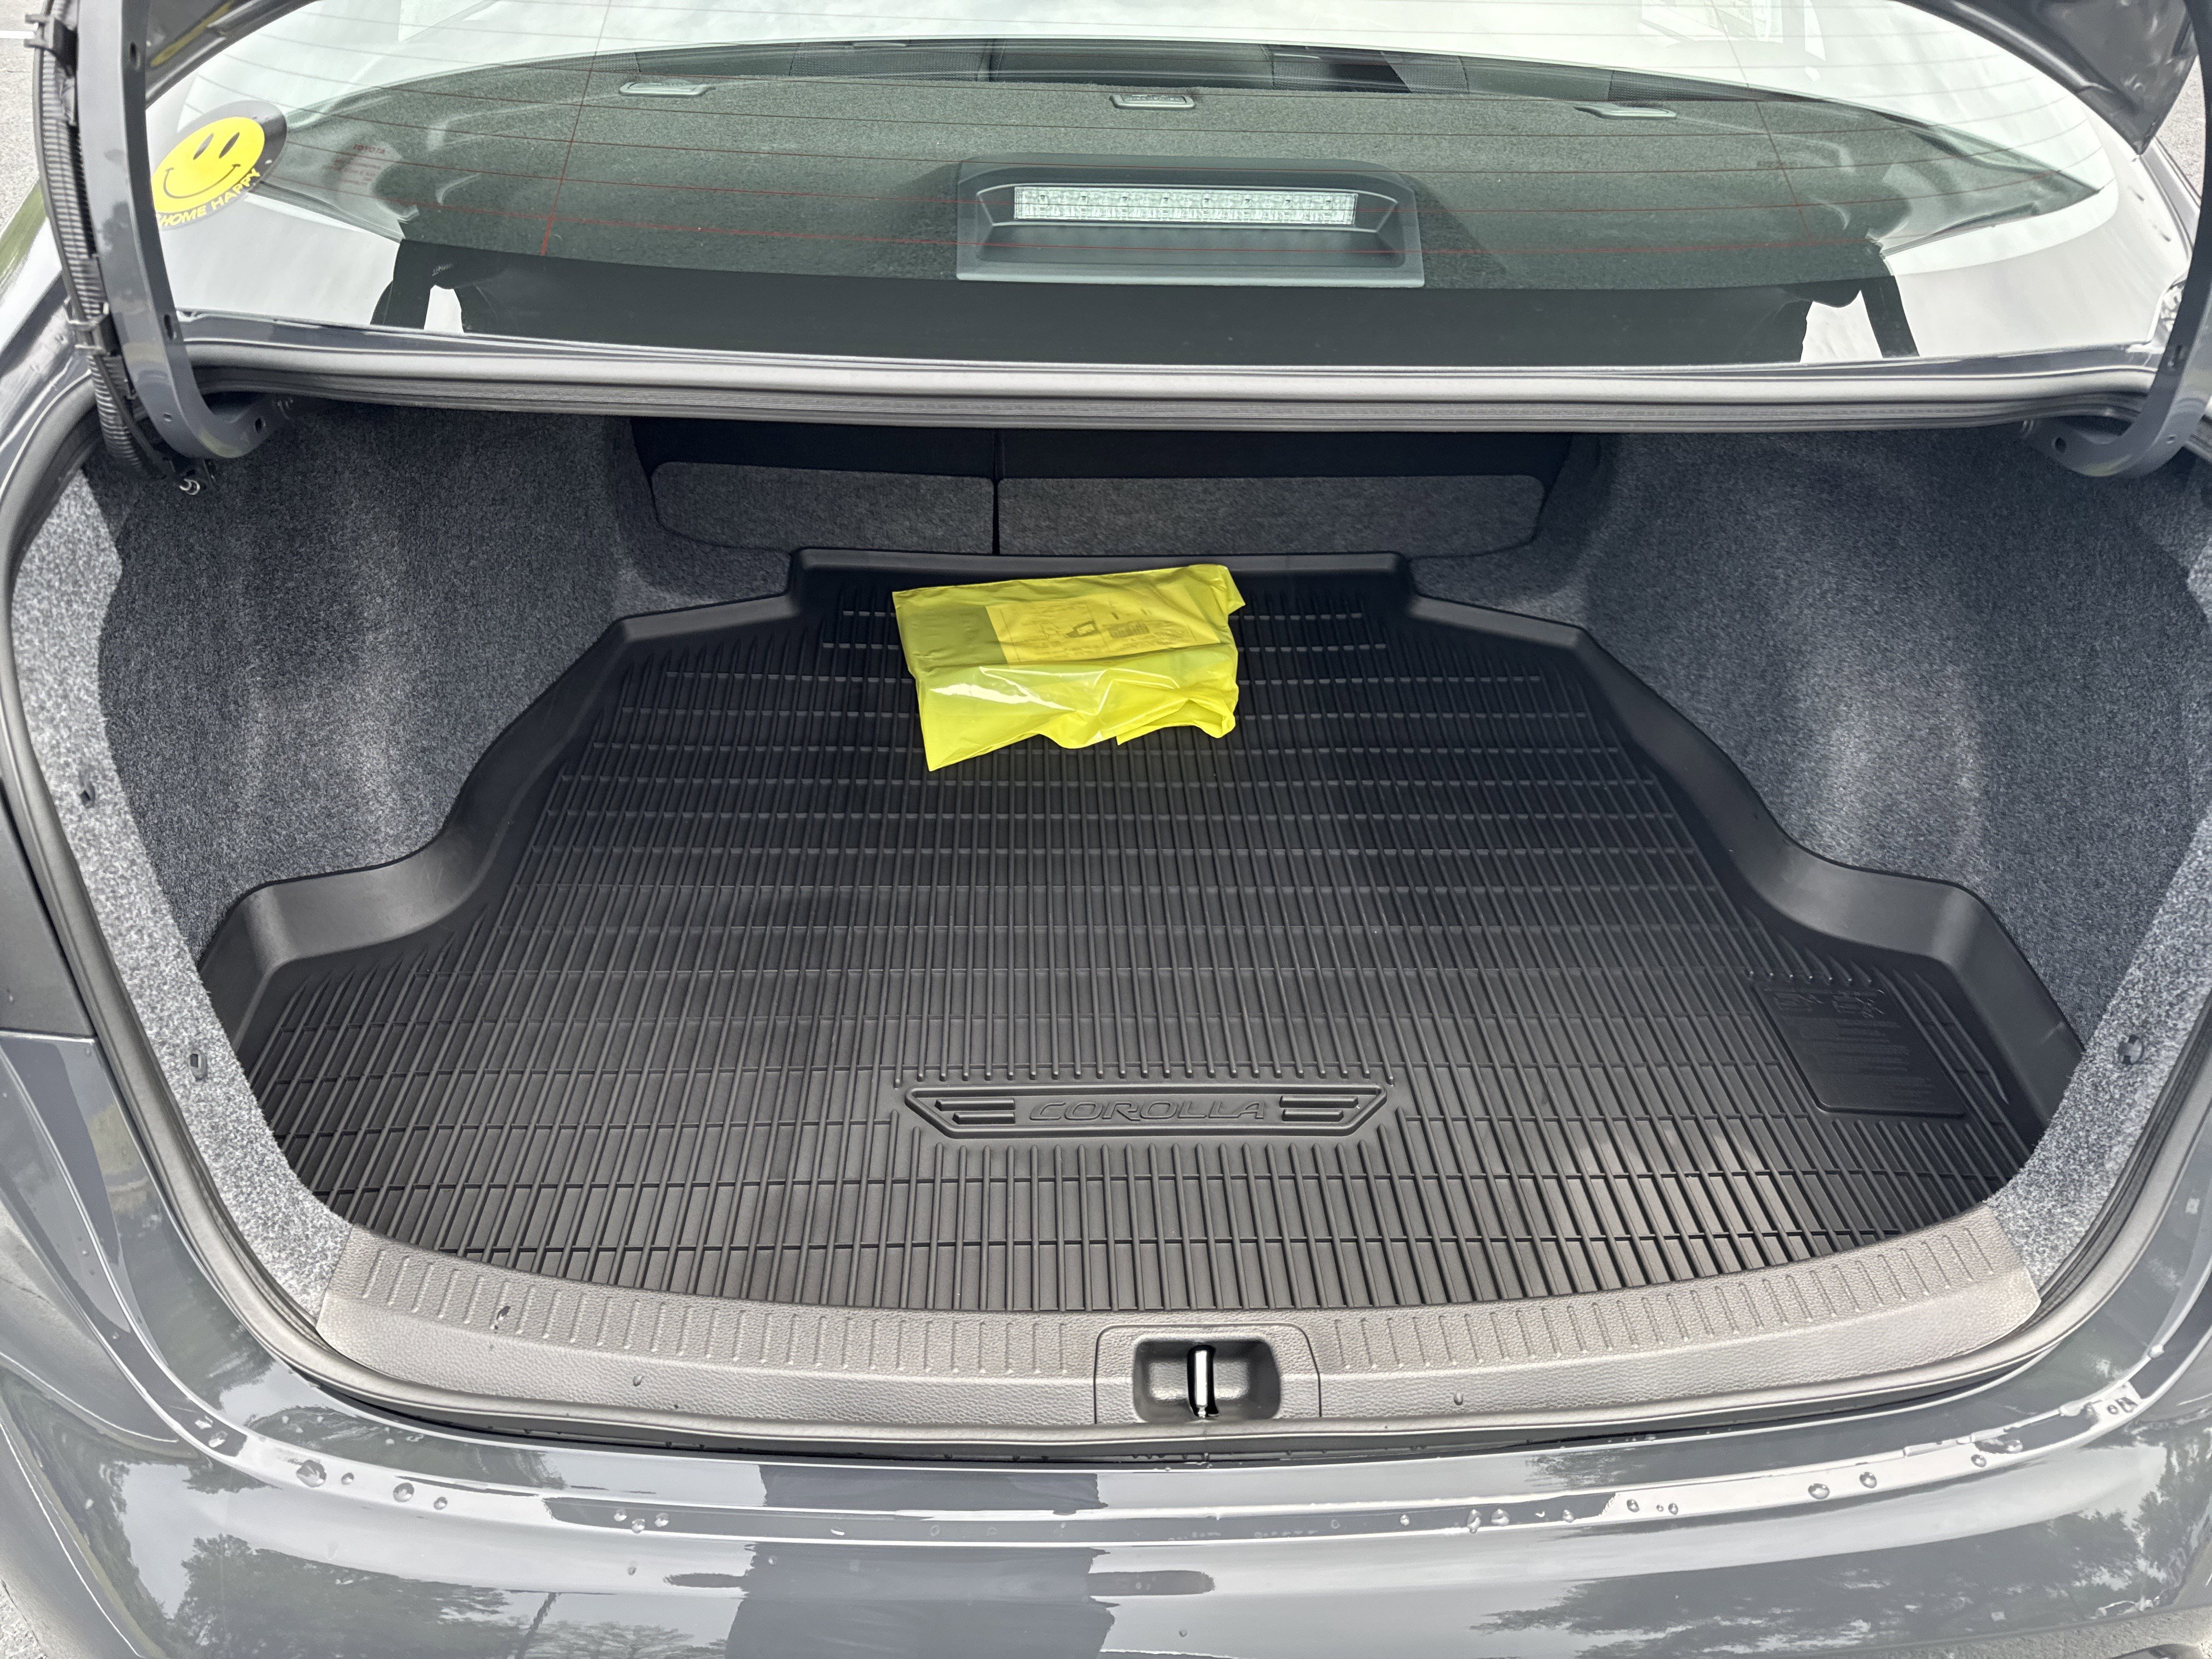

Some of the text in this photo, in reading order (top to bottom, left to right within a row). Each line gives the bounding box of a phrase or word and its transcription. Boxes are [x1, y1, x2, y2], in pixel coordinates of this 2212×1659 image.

[353, 144, 386, 155] TOYOTA
[158, 168, 261, 227] HOME HAPPY
[1029, 1100, 1265, 1121] COROLLA
